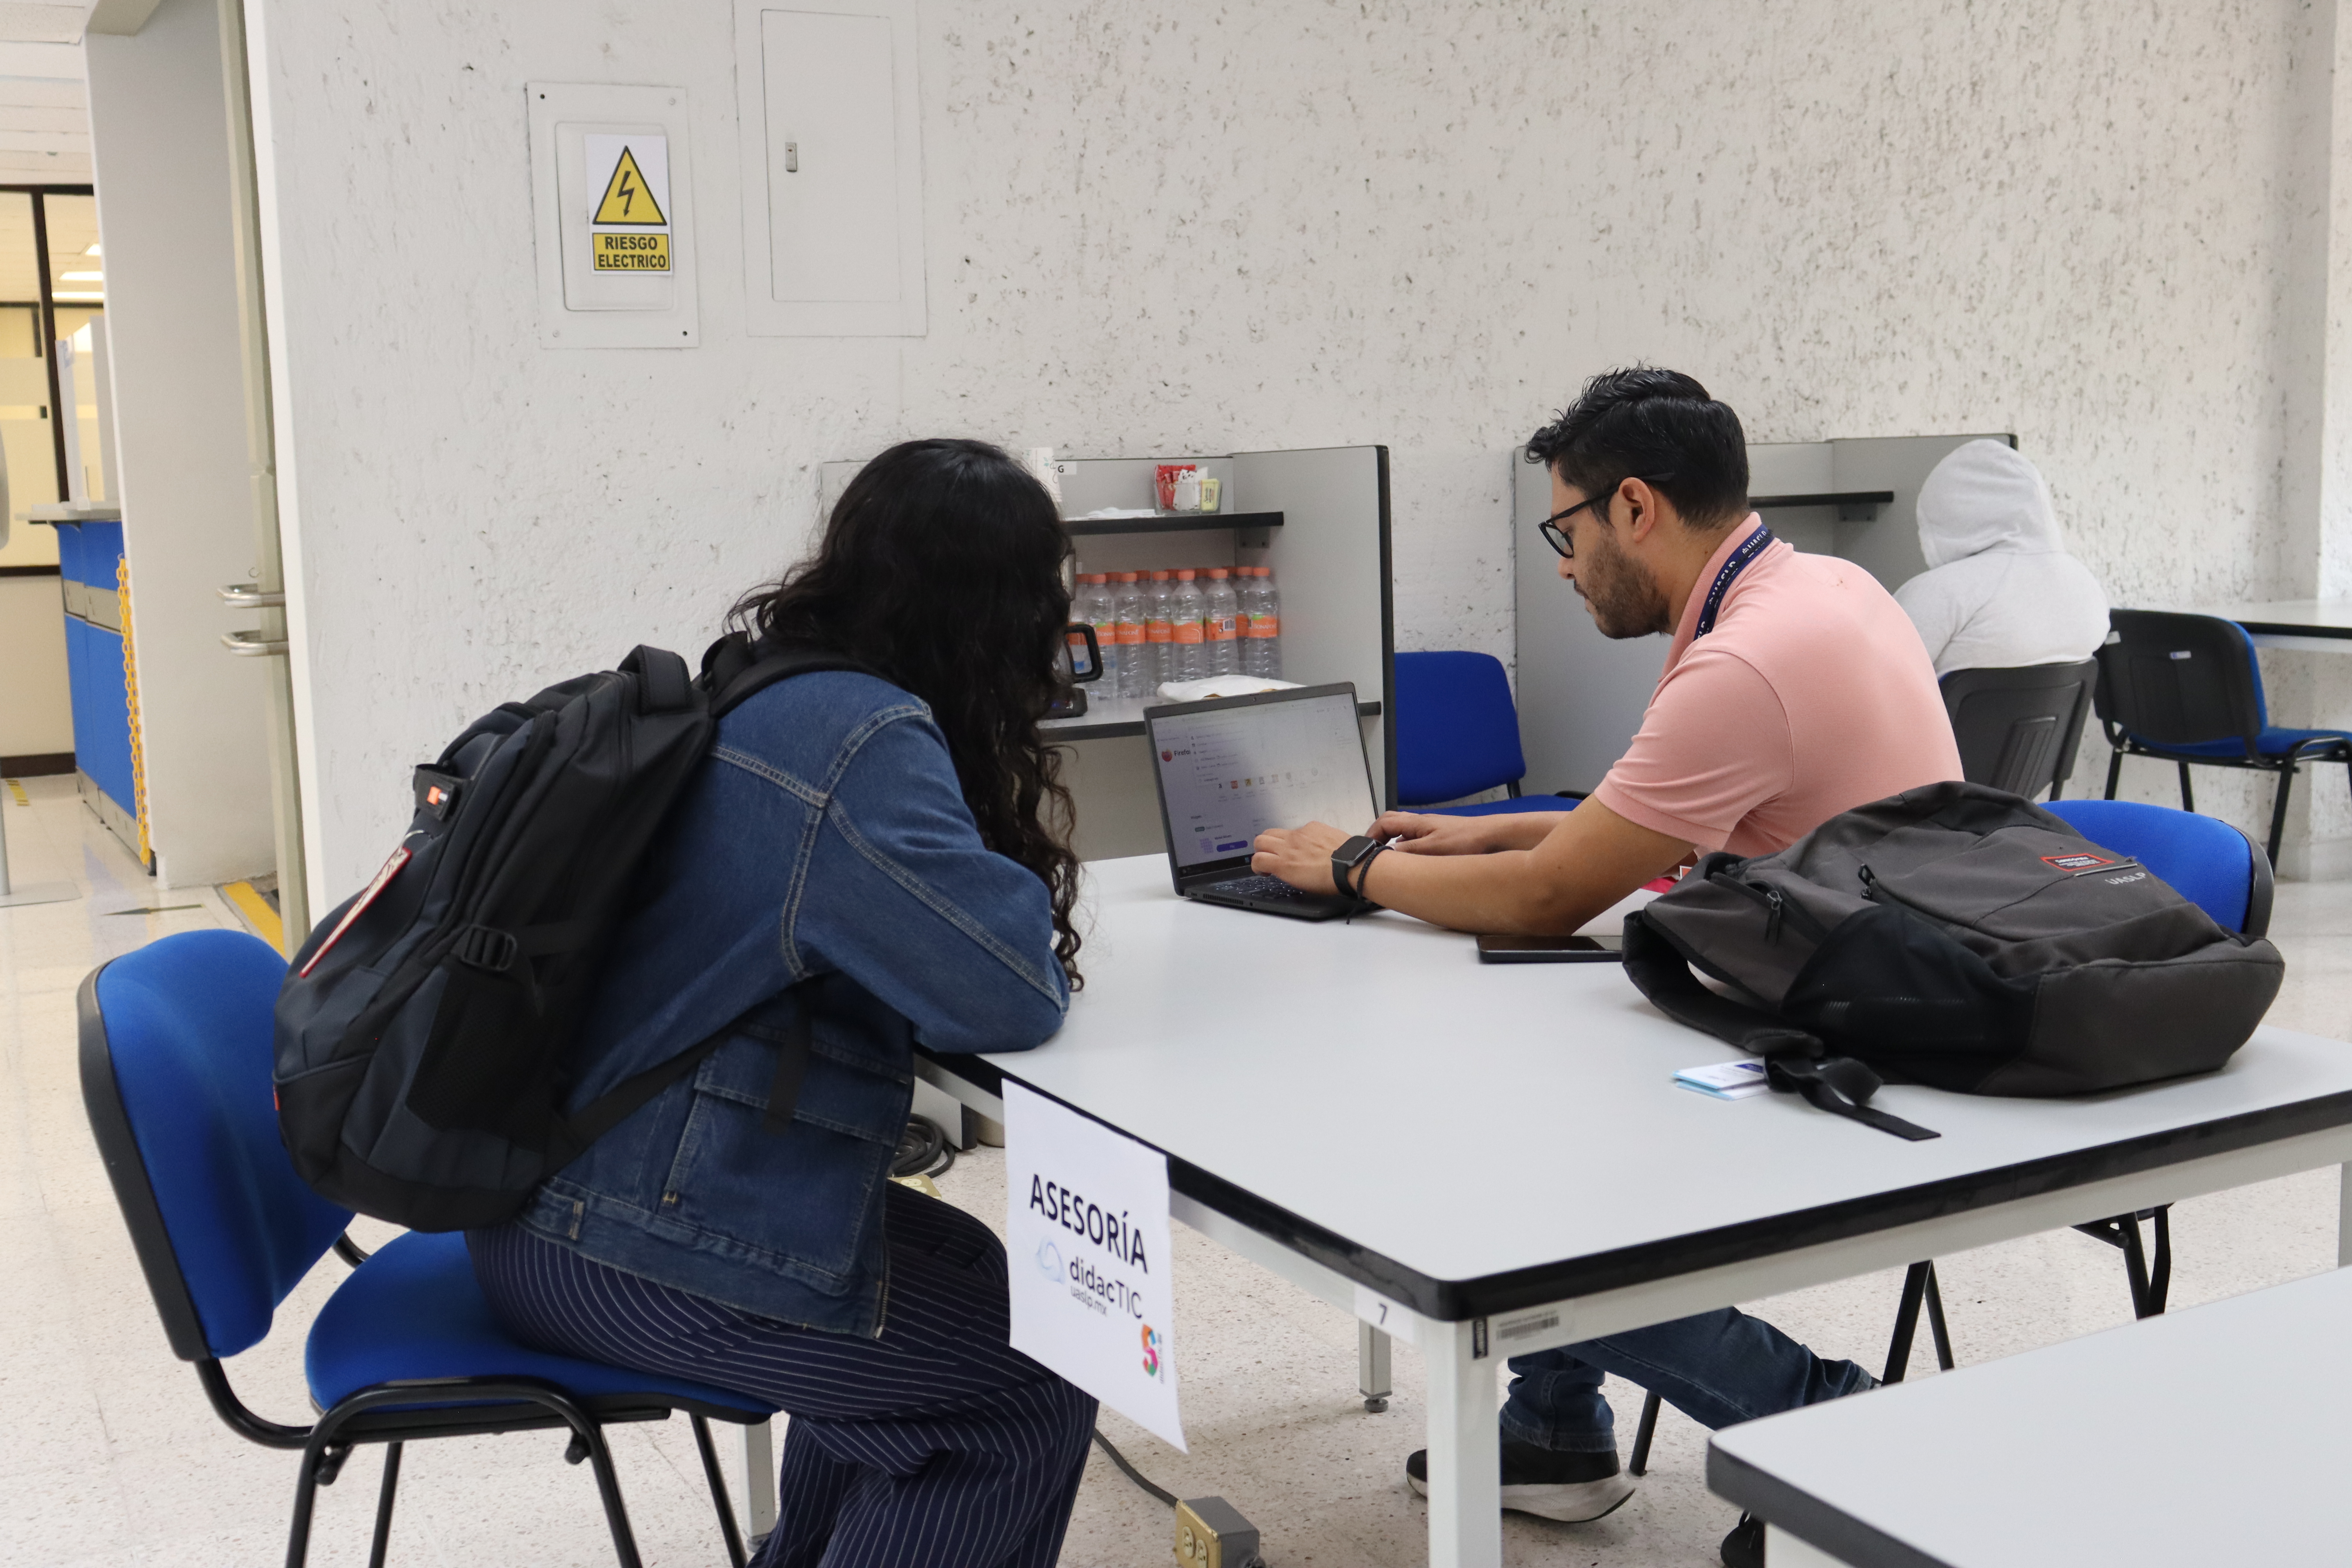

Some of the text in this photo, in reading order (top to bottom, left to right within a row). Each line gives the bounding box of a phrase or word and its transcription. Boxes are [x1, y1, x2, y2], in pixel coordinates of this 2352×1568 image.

[605, 236, 657, 250] RIESGO
[598, 254, 666, 268] ELECTRICO
[2105, 872, 2146, 884] UASLP
[1030, 1174, 1148, 1274] ASESORÍA
[1070, 1256, 1142, 1319] didacTIC
[1379, 1303, 1388, 1325] 7
